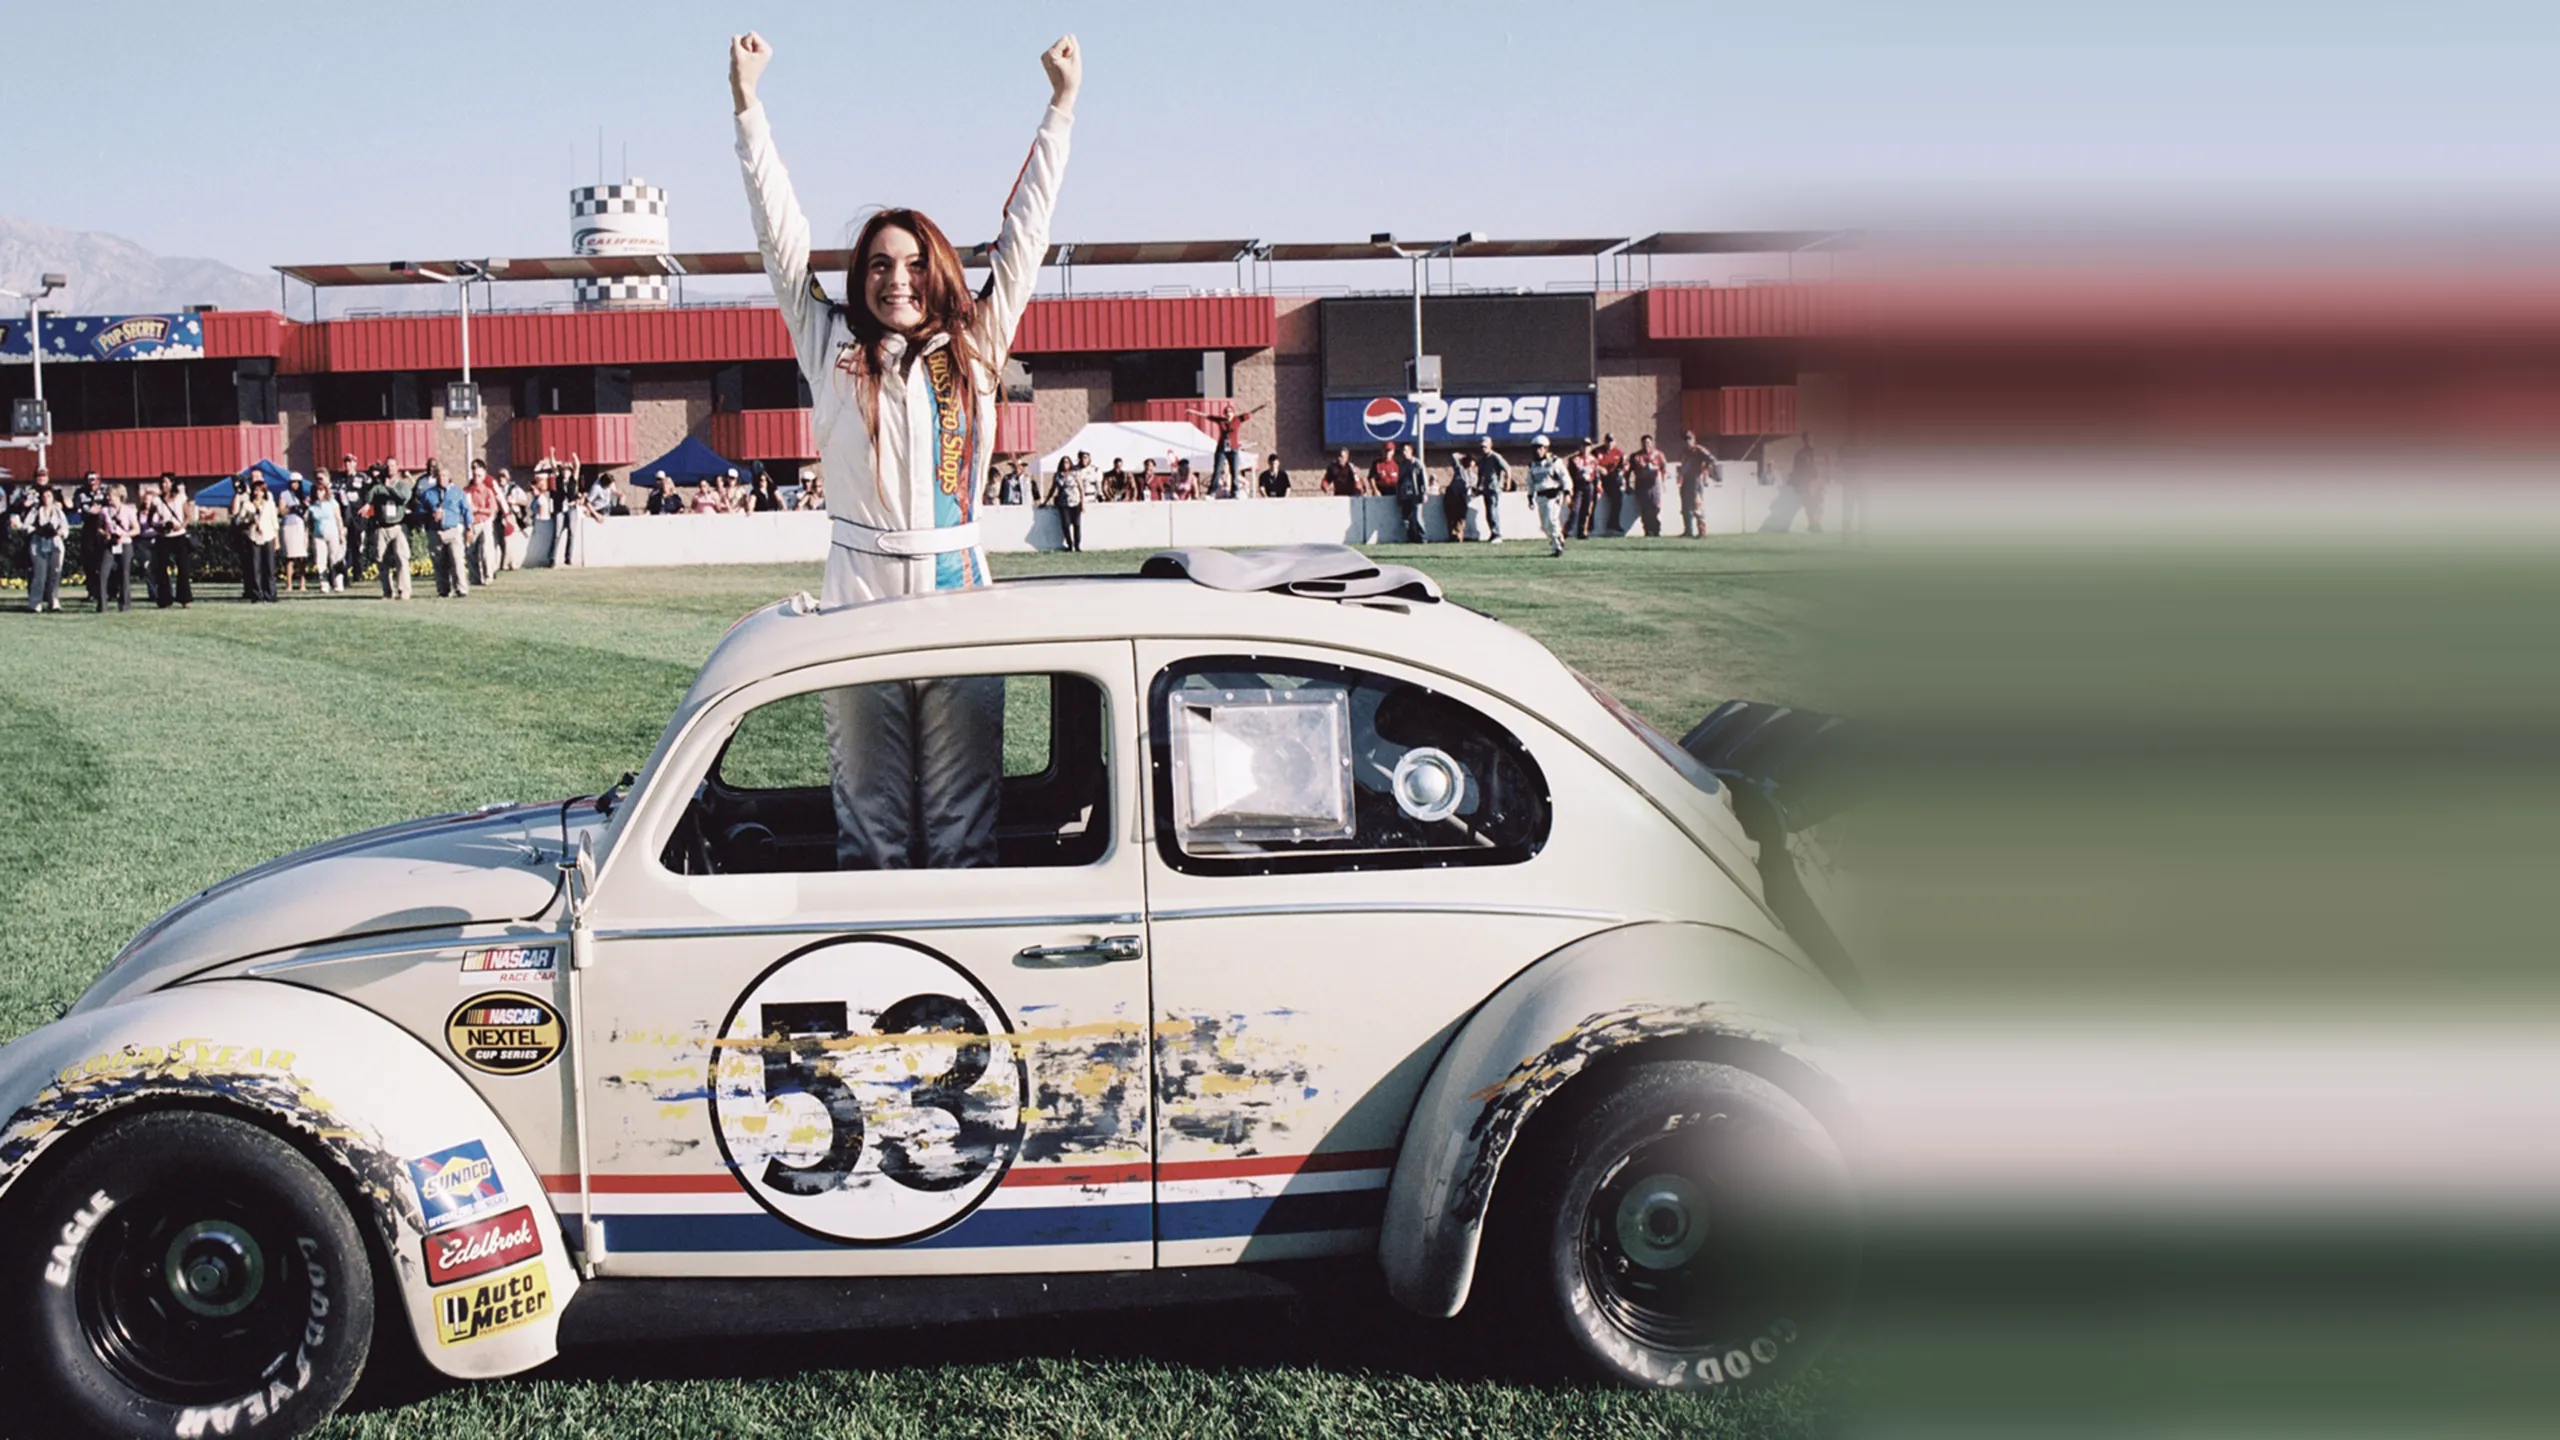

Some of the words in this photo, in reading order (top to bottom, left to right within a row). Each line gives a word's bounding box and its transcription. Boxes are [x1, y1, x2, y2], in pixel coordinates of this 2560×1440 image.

[98, 319, 165, 352] POP-SECRET
[1411, 396, 1561, 437] PEPSI
[937, 435, 963, 494] Shops
[490, 949, 551, 969] NASCAR
[499, 972, 528, 982] RACE
[533, 971, 557, 980] CAR
[489, 1008, 539, 1025] NASCAR
[467, 1028, 543, 1046] NEXTEL
[475, 1050, 498, 1060] CUP
[499, 1050, 539, 1060] SERIES
[760, 992, 993, 1197] 53
[426, 1160, 490, 1196] SUNOCO
[44, 1188, 116, 1288] EAGLE
[438, 1218, 533, 1270] Edelbrock
[473, 1274, 534, 1310] Auto
[467, 1290, 547, 1338] Meter
[1570, 1281, 1798, 1387] GOODY
